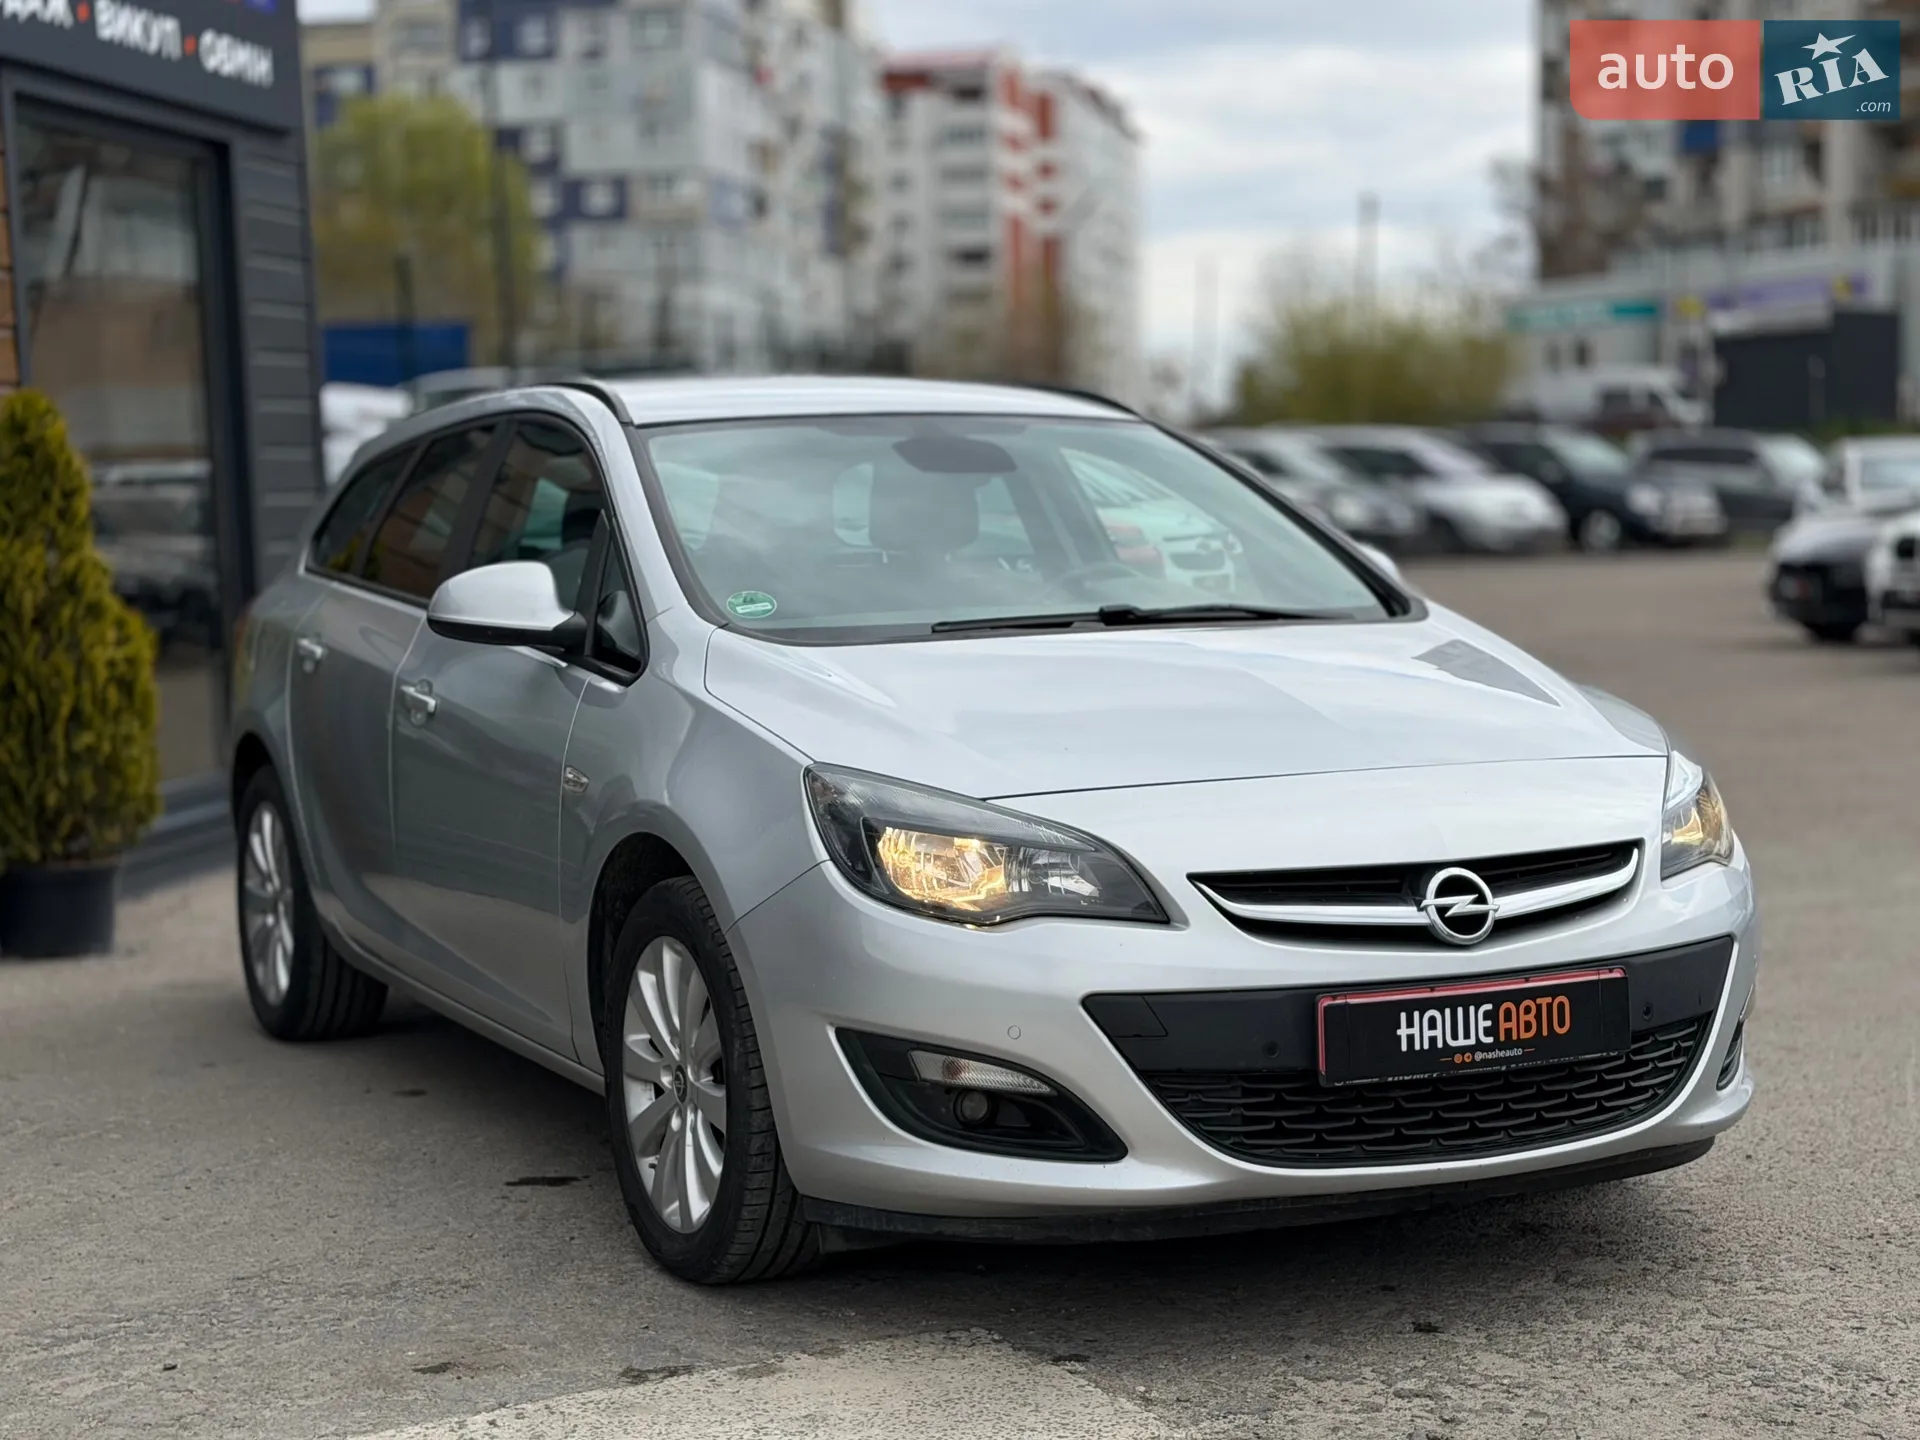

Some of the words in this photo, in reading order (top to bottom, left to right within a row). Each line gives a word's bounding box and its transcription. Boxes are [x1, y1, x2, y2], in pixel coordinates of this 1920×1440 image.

[1396, 1003, 1494, 1052] НАШЕ
[1498, 995, 1571, 1042] АВТО
[1474, 1048, 1523, 1062] @nasheauto
